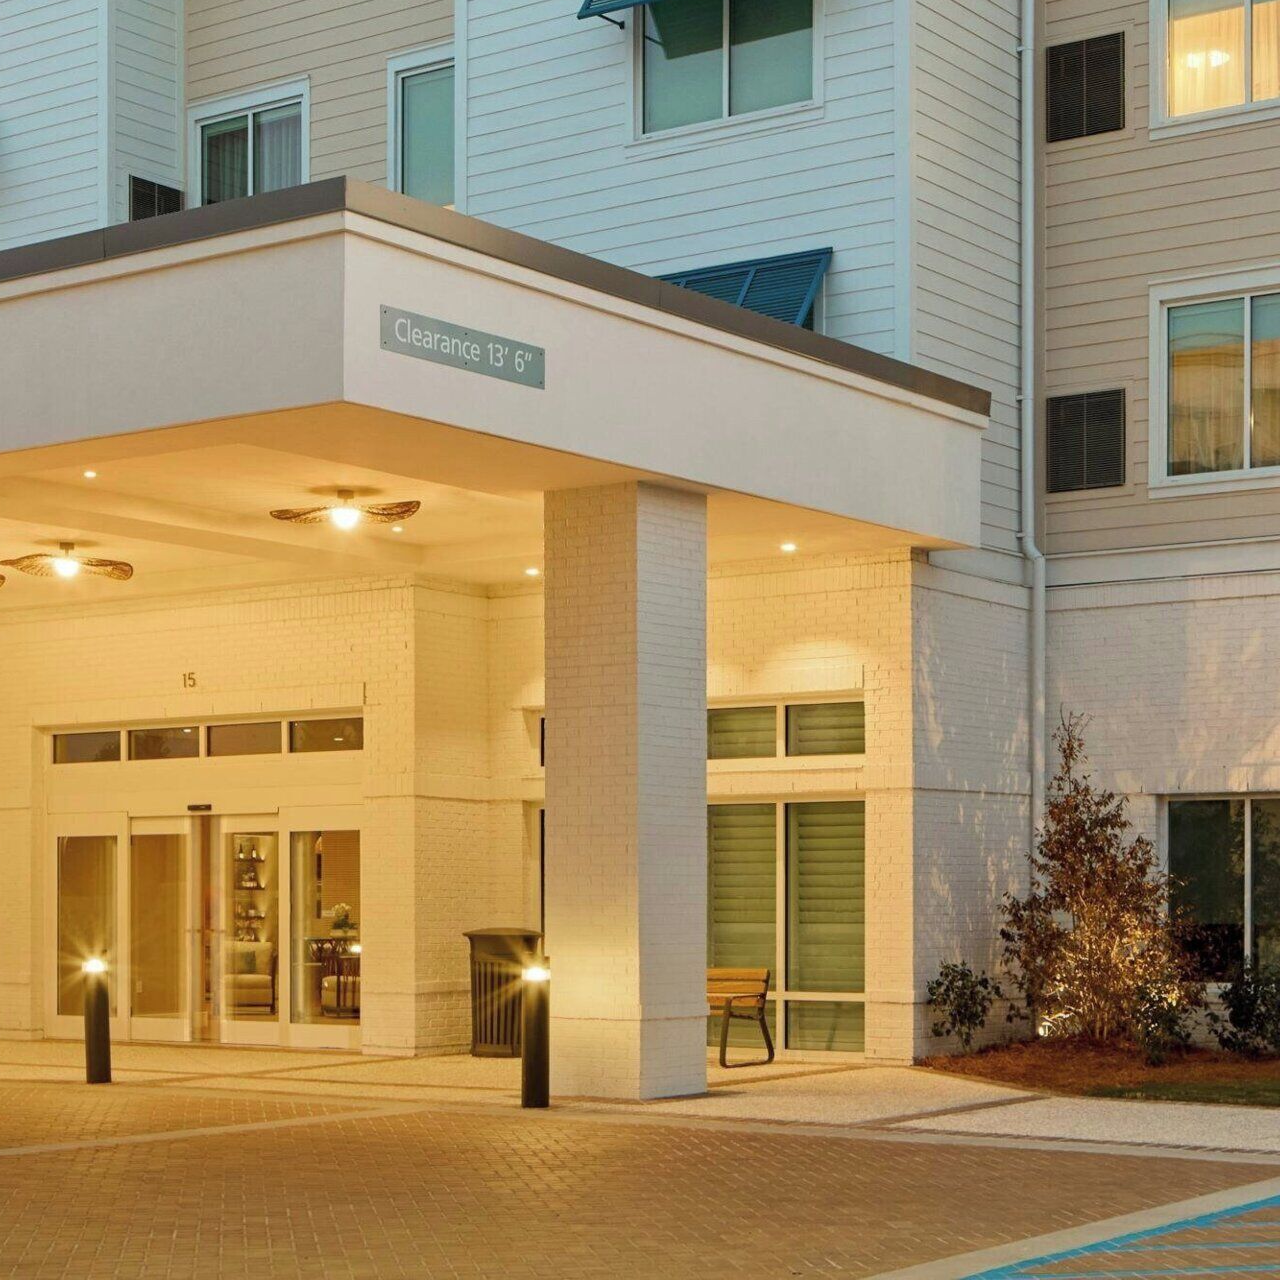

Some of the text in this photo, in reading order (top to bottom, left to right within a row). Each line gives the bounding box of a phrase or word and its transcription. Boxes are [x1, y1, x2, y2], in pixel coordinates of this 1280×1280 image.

[394, 318, 481, 362] Clearance
[487, 342, 509, 368] 13'
[182, 671, 197, 689] 15
